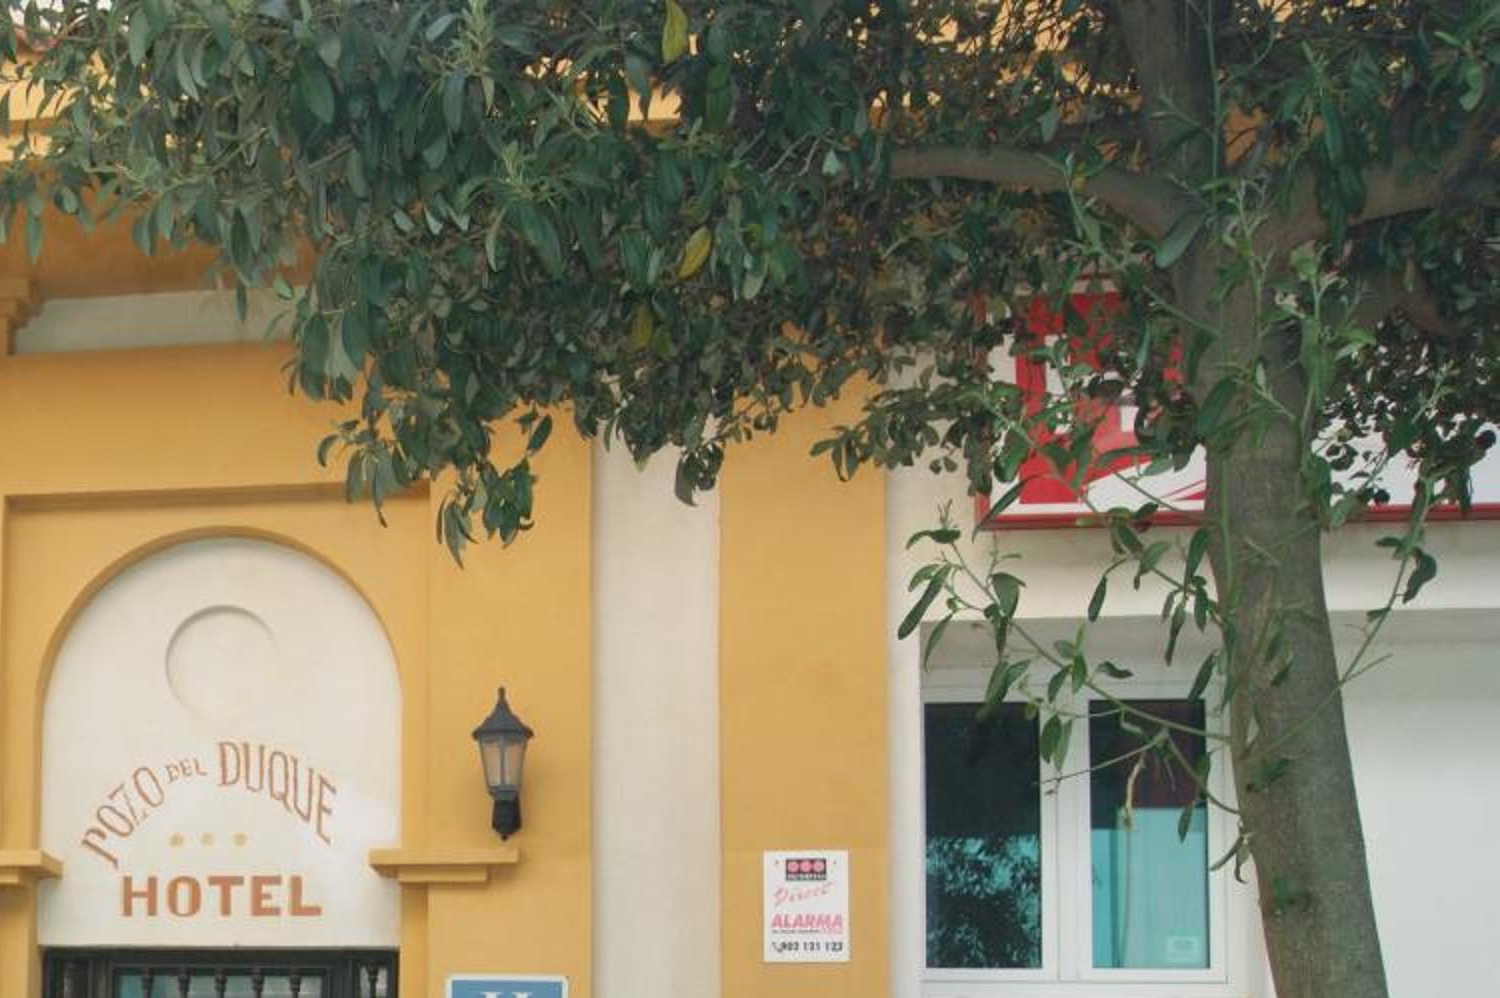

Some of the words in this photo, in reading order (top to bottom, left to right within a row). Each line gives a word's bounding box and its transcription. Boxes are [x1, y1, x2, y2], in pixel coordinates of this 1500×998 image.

[81, 766, 164, 869] POZO
[164, 757, 208, 785] DEL
[216, 740, 337, 846] DUQUE
[121, 875, 323, 917] HOTEL
[771, 914, 843, 928] ALARMA
